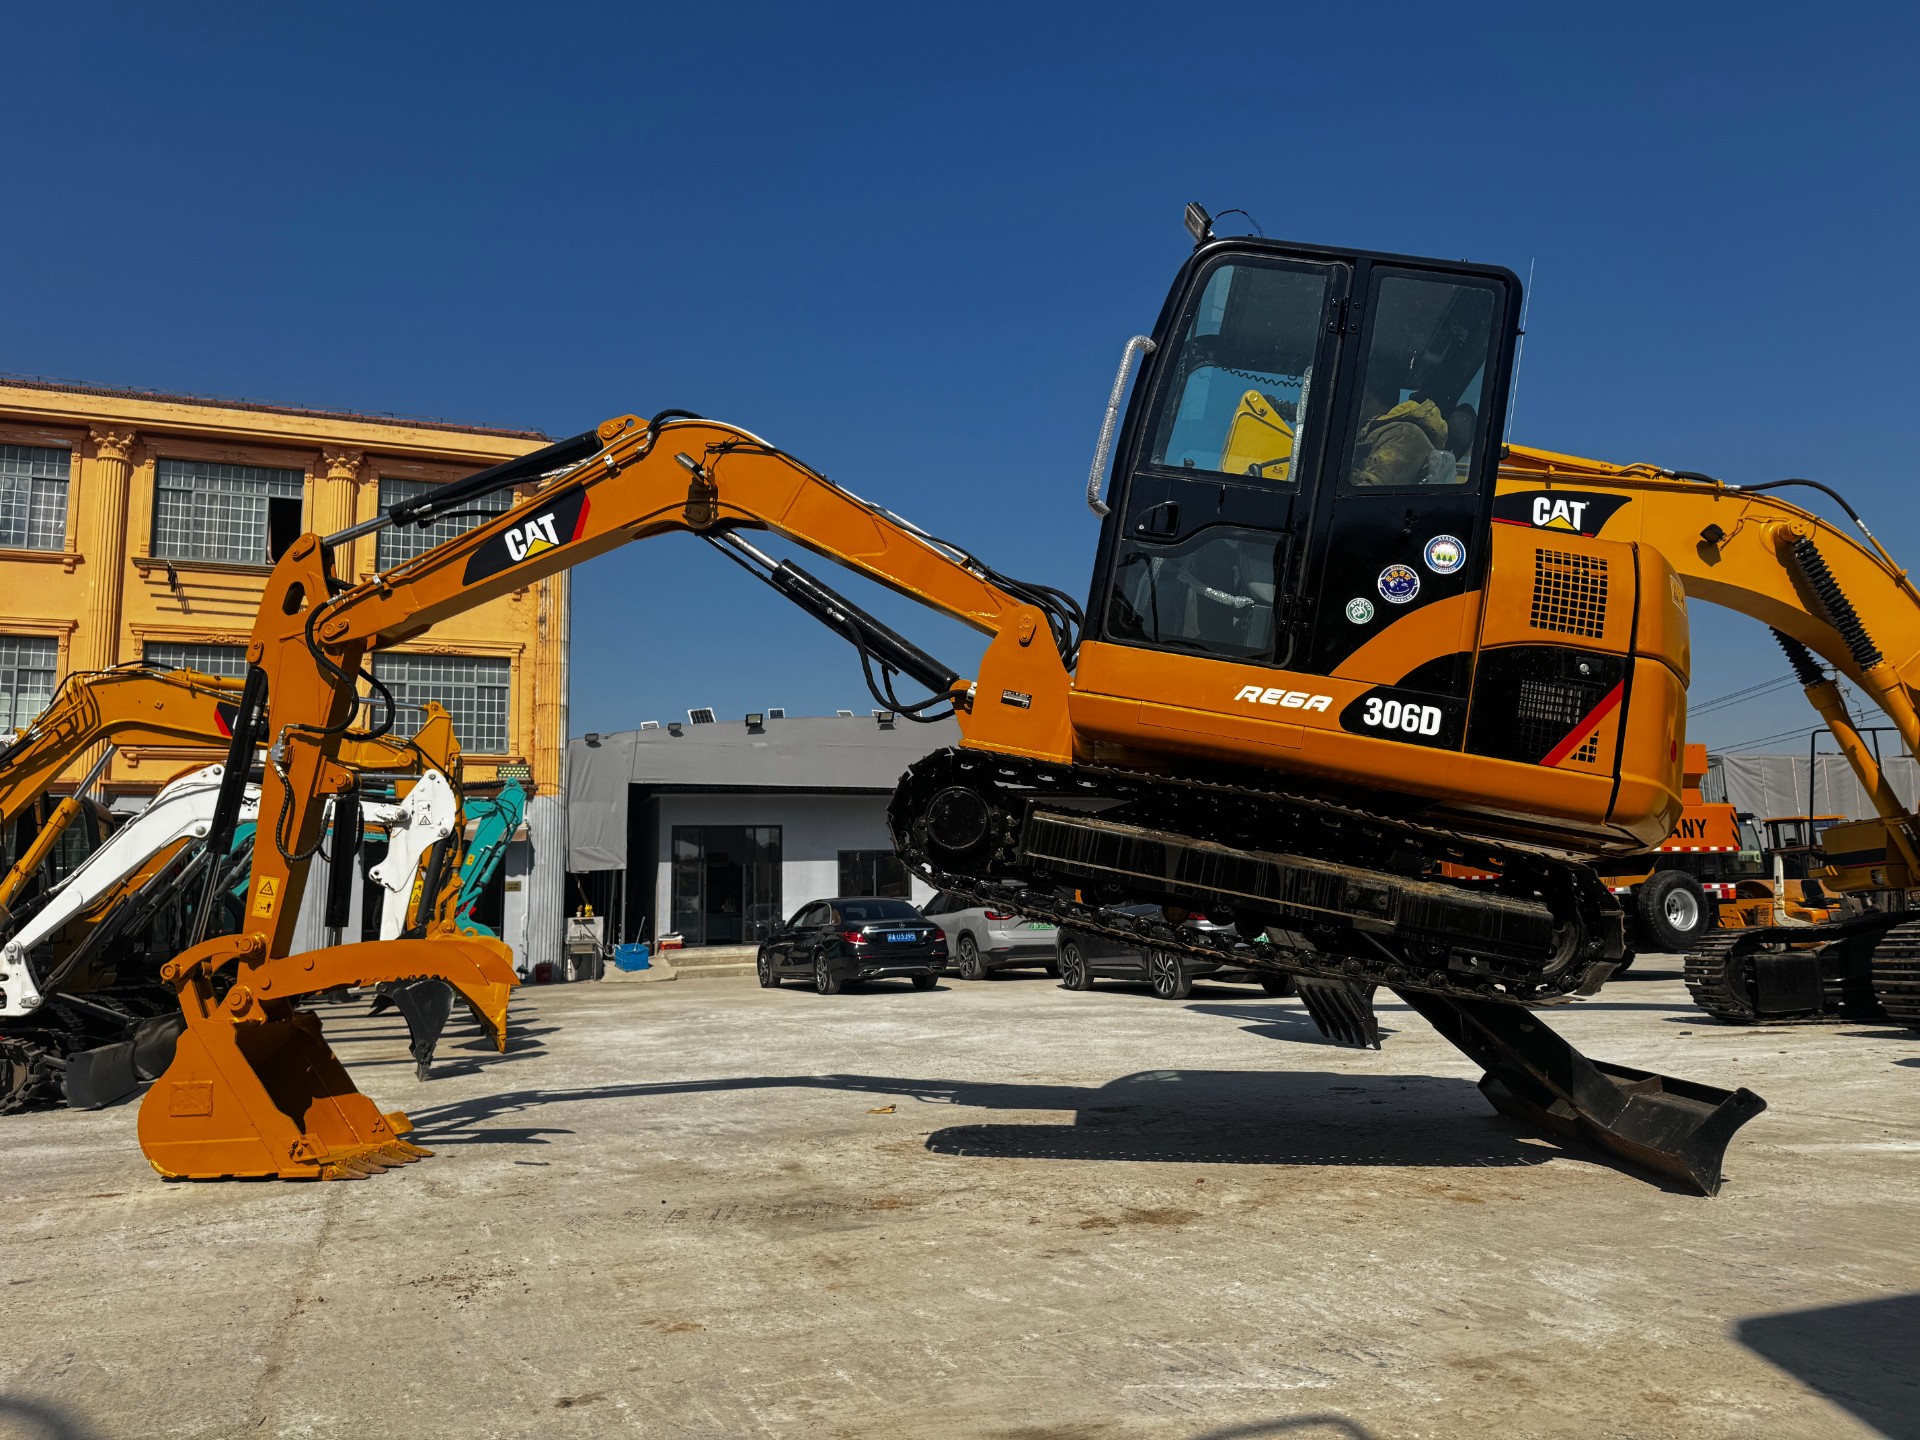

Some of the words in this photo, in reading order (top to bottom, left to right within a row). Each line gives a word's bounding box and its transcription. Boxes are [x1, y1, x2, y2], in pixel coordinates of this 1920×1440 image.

[1533, 497, 1586, 531] CAT
[504, 513, 560, 562] CAT
[1233, 685, 1333, 712] REGA
[1363, 697, 1442, 736] 306D
[1667, 818, 1707, 838] ANY
